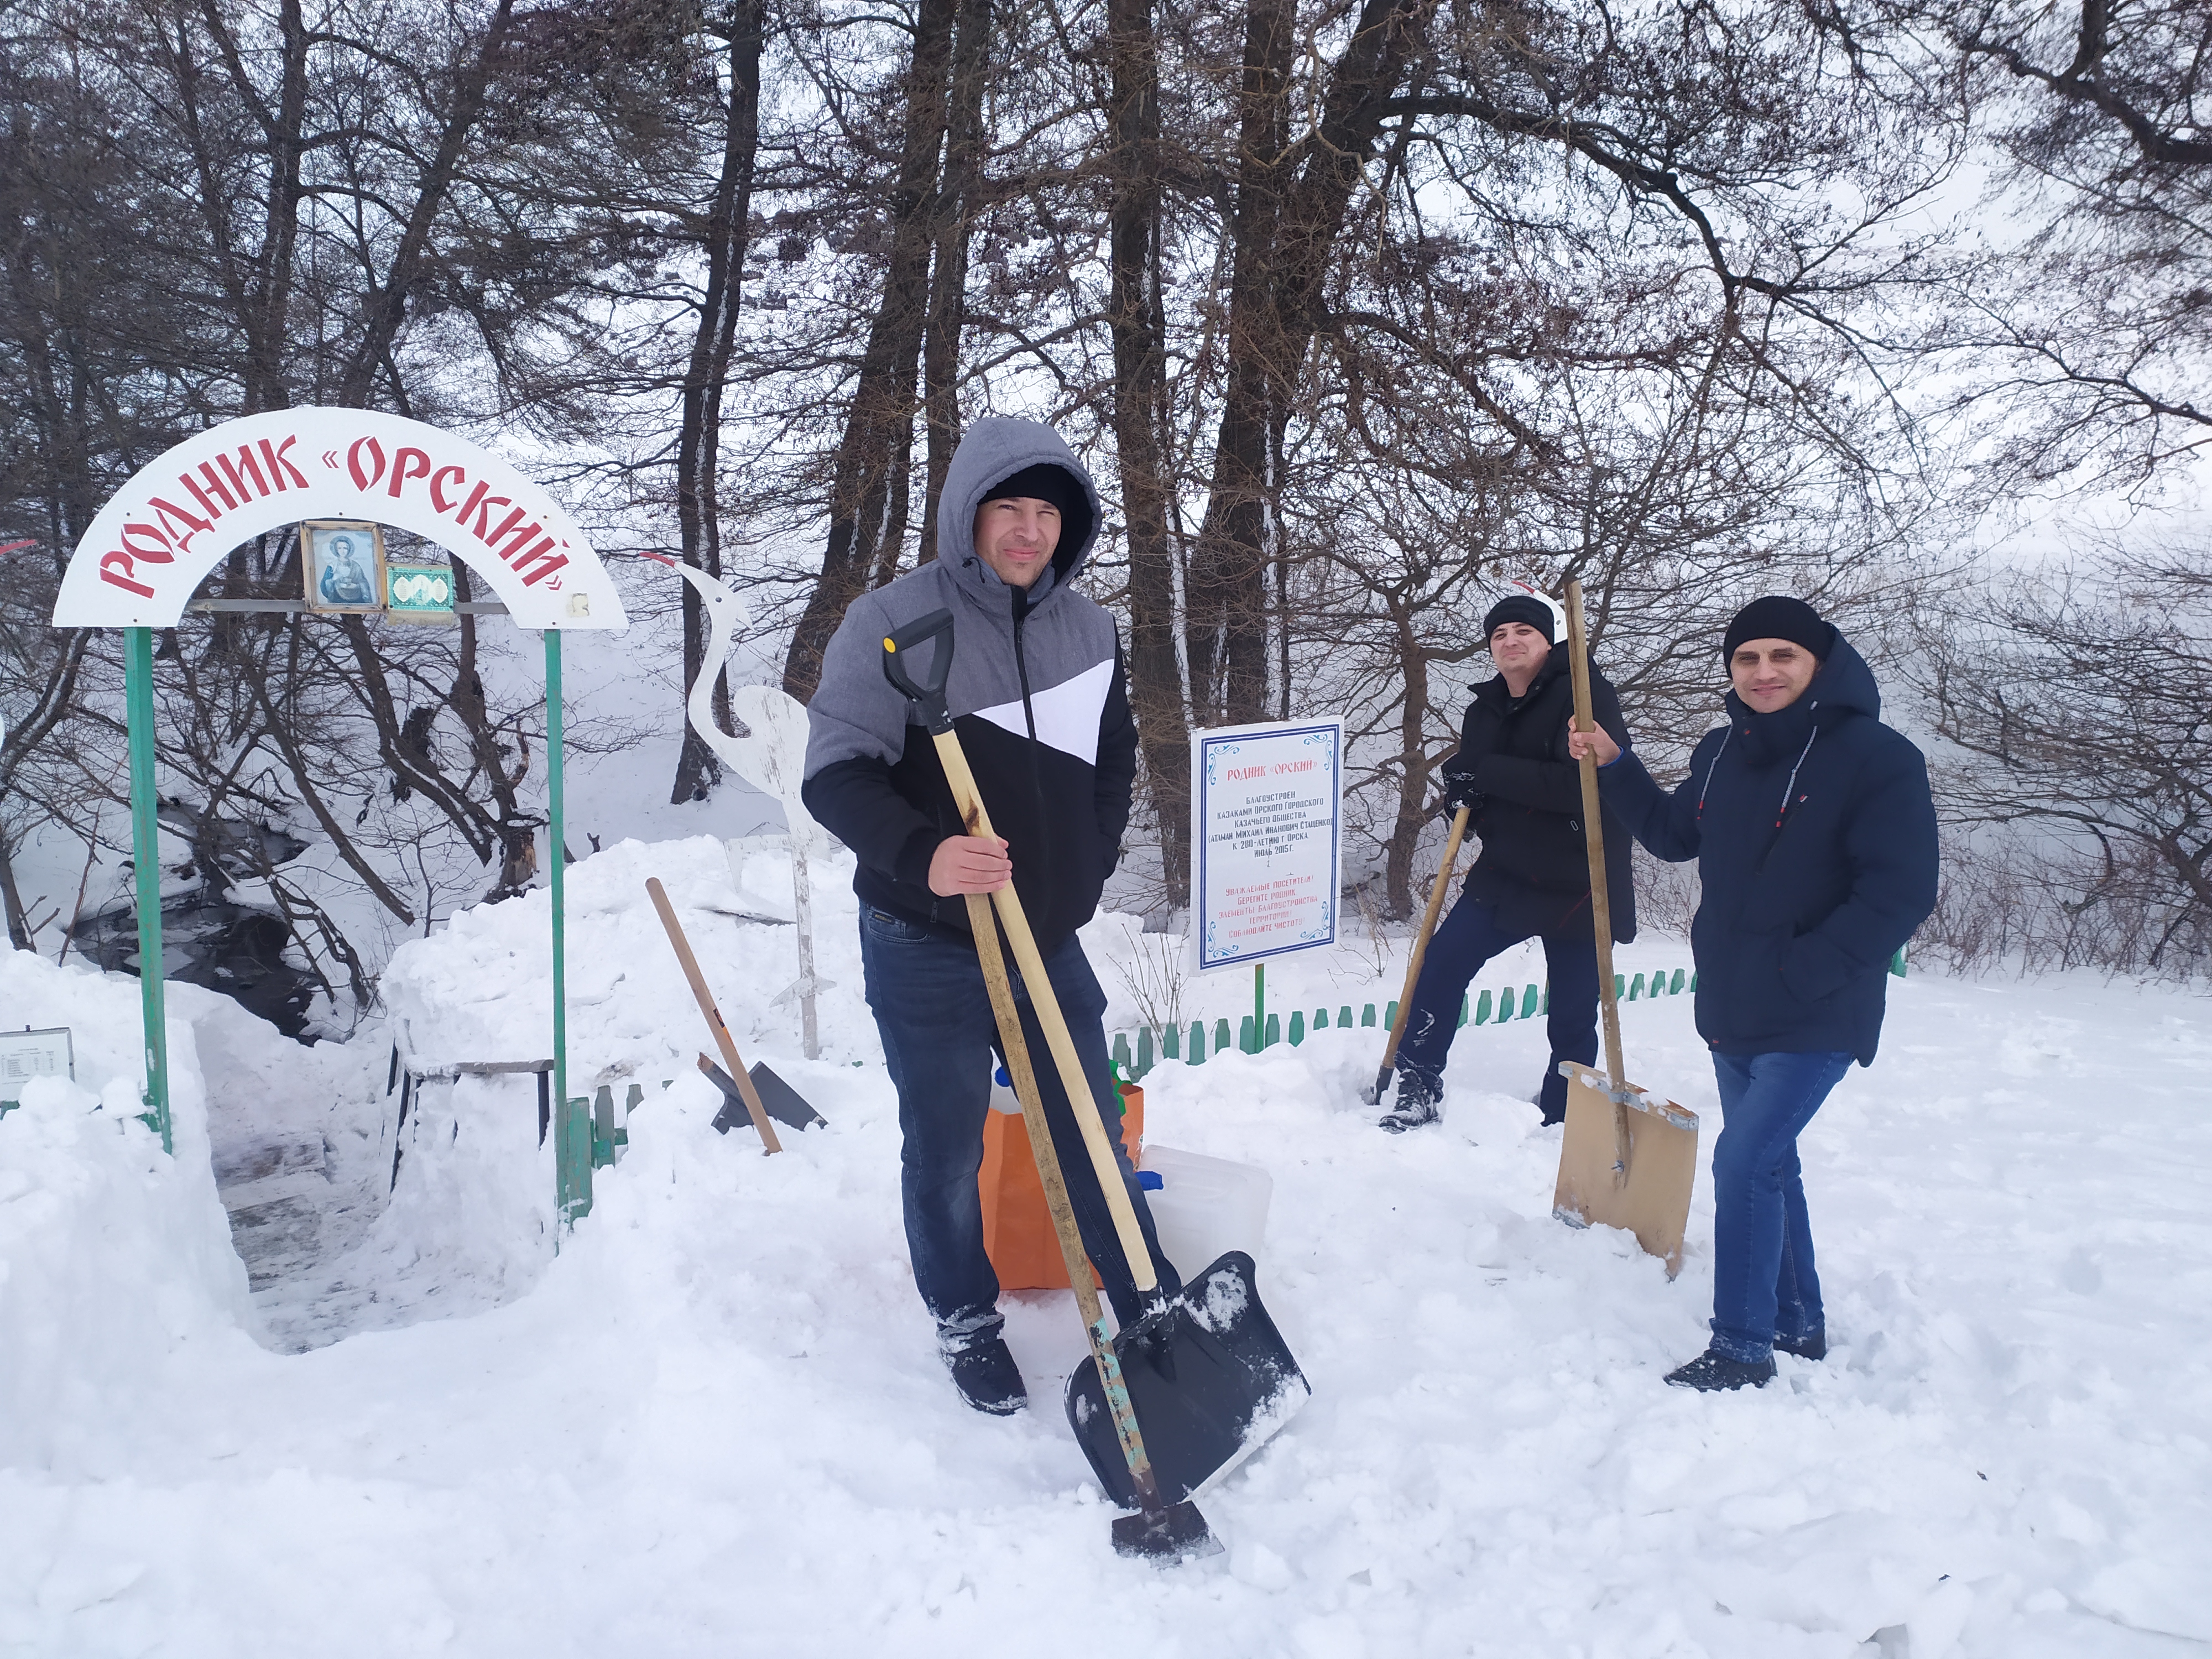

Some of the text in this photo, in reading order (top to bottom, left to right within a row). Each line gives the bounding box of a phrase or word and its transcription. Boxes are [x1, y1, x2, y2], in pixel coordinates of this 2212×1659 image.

[99, 433, 571, 599] РОДНИК «ОРСКИЙ»
[1227, 758, 1318, 781] РОДНИК «ОРСКИЙ»
[1246, 791, 1296, 805] БЛАГОУСТРОЕН
[1217, 797, 1324, 820] КАЗАКАМИ ОРСКОГО ГОРОДСКОГО
[1234, 811, 1307, 828] КАЗАЧЬЕГО ОБЩЕСТВА
[1208, 817, 1332, 843] (АТАМАН МИХАИЛ ИВАНОВИЧ СТАЦЕНКО)
[1254, 848, 1272, 858] ИЮЛЬ
[1225, 883, 1270, 896] УВАЖАЕМЫЕ
[1238, 893, 1267, 905] БЕРЕГИТЕ
[1218, 906, 1255, 919] ЭЛЕМЕНТЫ
[1229, 924, 1272, 938] СОБЛЮДАЙТЕ
